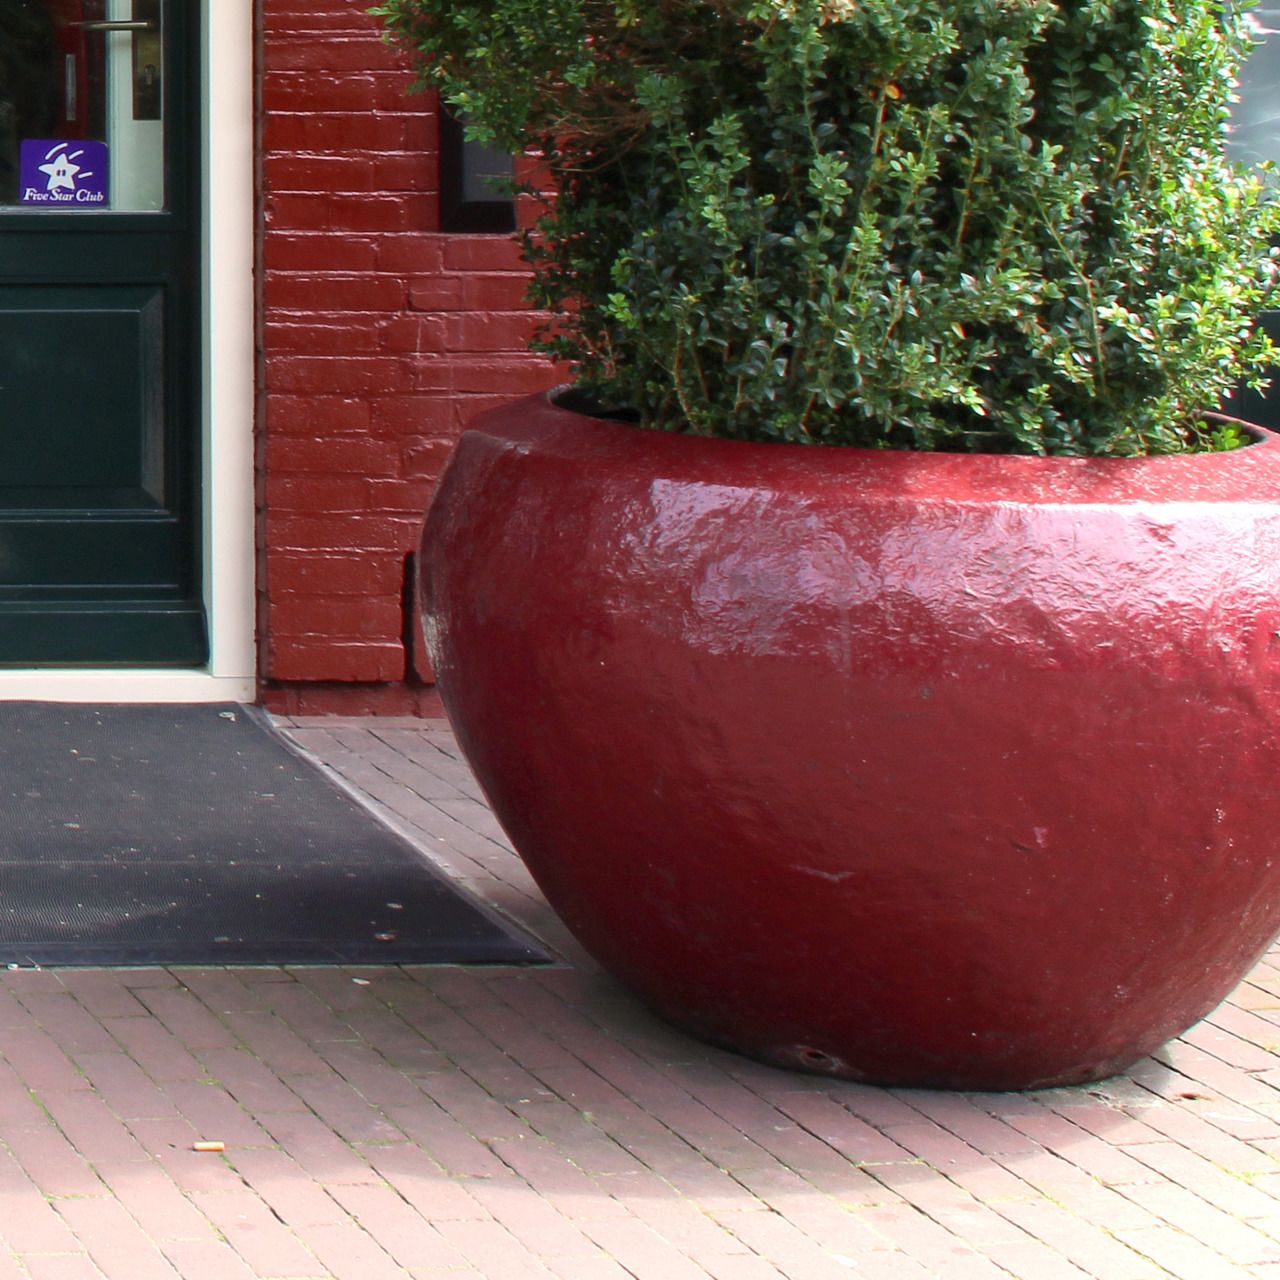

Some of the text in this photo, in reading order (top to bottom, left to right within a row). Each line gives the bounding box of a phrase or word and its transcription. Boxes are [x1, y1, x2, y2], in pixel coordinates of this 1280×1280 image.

[23, 187, 104, 202] Five Star Club
